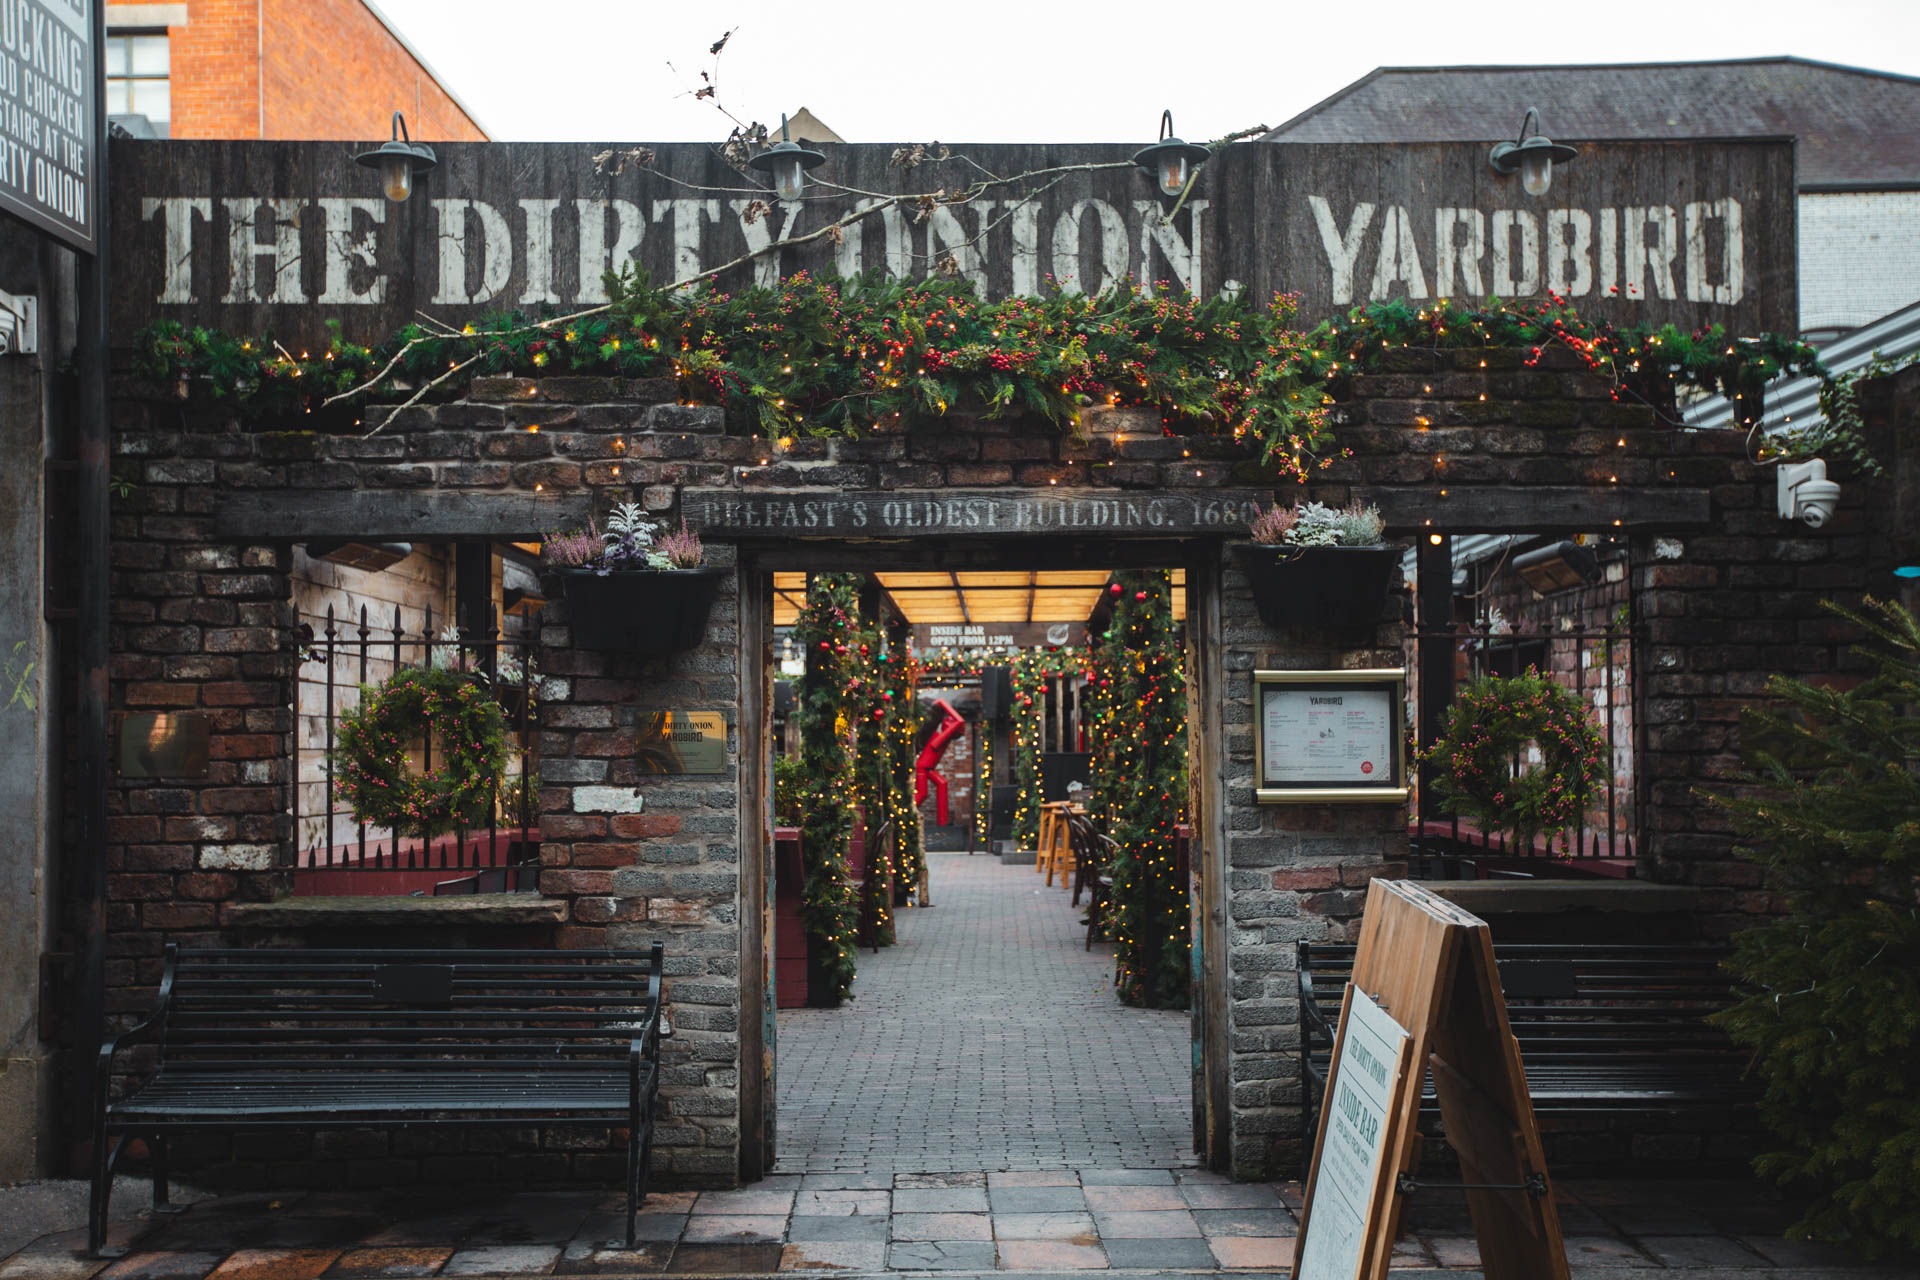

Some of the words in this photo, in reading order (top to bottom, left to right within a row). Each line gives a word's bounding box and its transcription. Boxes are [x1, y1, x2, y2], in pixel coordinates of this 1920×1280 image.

[0, 0, 82, 97] UCKING
[24, 68, 84, 140] CHICKEN
[45, 124, 59, 161] AT
[63, 135, 84, 177] THE
[35, 156, 85, 225] ONION
[142, 197, 388, 304] THE
[430, 198, 803, 305] DIRTY
[1308, 194, 1745, 305] YARDBIRD
[882, 500, 1000, 528] OLDEST
[1015, 499, 1175, 528] BUILDING.
[930, 626, 962, 636] INSIDE
[964, 626, 984, 636] BAR
[930, 635, 956, 646] OPEN
[958, 635, 986, 646] FROM
[988, 635, 1014, 645] 12PM
[1309, 696, 1343, 706] YARDBIRD
[661, 732, 703, 742] YARDBIRD
[1338, 1080, 1362, 1129] INSIDE
[1359, 1106, 1378, 1150] BAR
